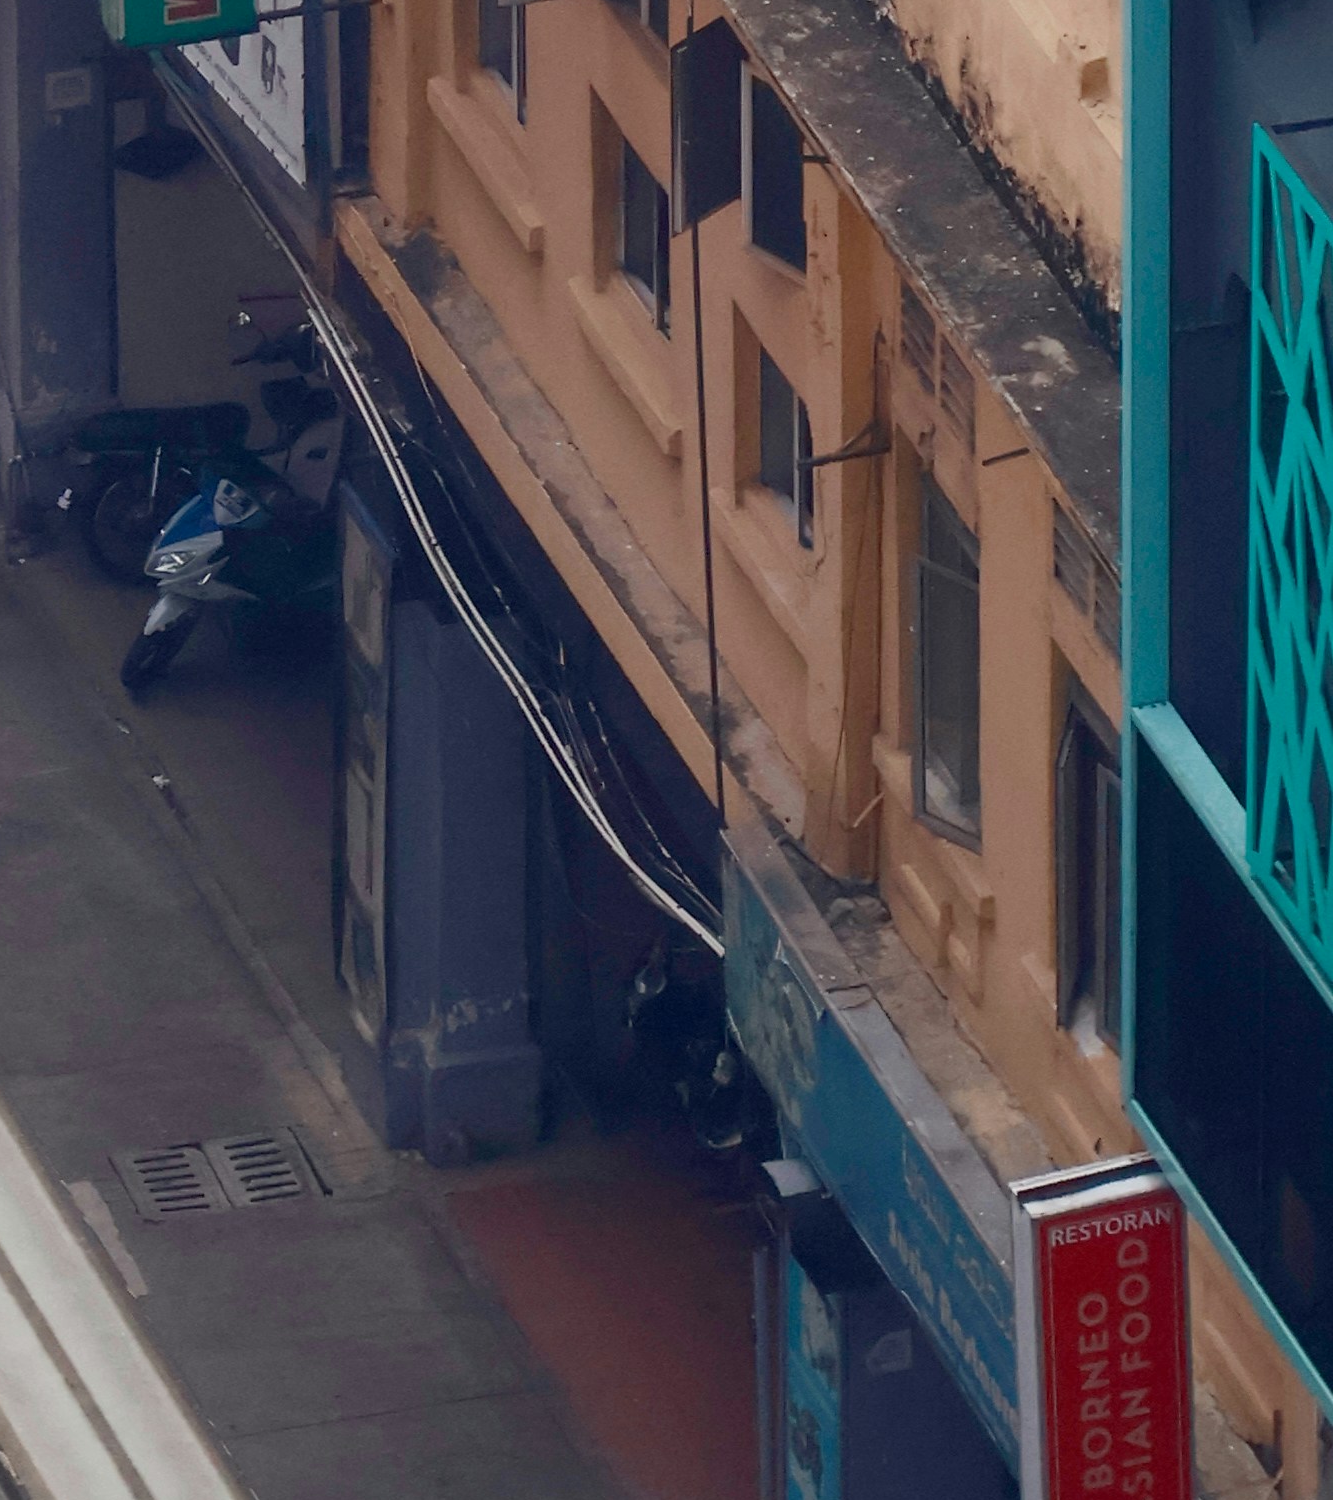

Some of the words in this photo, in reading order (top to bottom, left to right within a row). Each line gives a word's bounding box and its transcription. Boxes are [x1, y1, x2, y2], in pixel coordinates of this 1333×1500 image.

[1049, 1206, 1174, 1249] RESTORAN
[1116, 1236, 1153, 1372] FOOD
[1077, 1291, 1115, 1491] BORNEO
